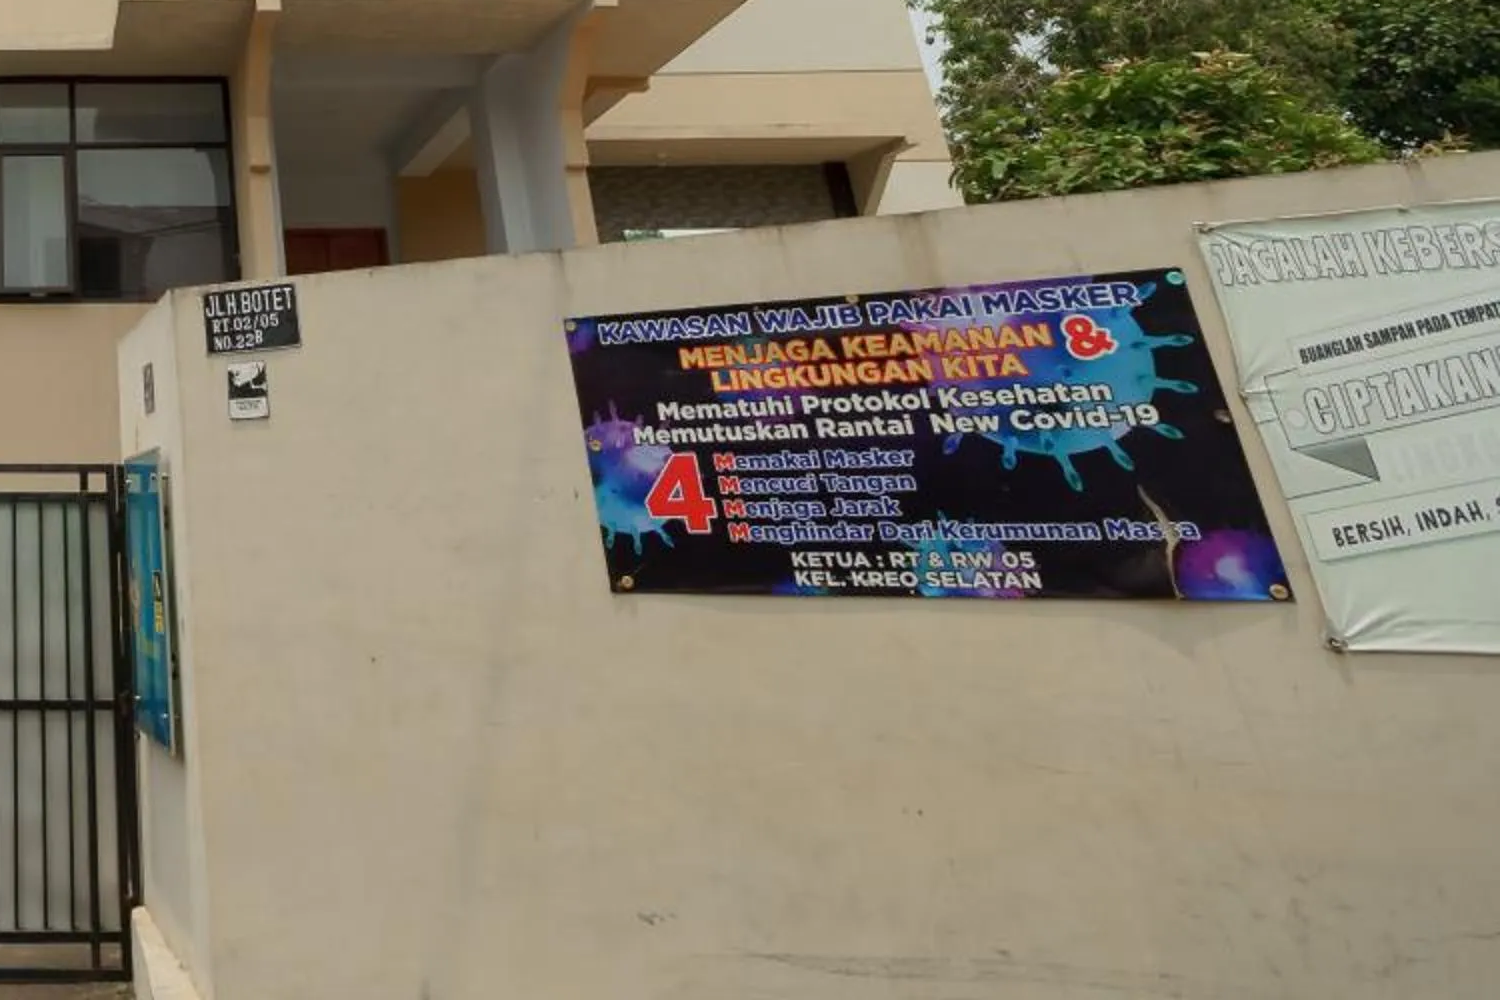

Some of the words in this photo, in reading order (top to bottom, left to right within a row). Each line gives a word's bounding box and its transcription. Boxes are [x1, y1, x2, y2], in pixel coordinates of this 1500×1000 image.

[1210, 233, 1368, 287] JAGALAH
[212, 312, 280, 334] RT.02/05
[599, 312, 751, 345] KAWASAN
[753, 304, 861, 333] WAJIB
[867, 294, 974, 325] PAKAI
[982, 281, 1143, 317] MASKER
[678, 338, 837, 370] MENJAGA
[841, 322, 1056, 359] KEAMANAN
[1060, 313, 1119, 361] &
[1299, 335, 1365, 364] BUANGLAH
[1362, 322, 1417, 349] SAMPAH
[1414, 313, 1452, 337] PADA
[711, 357, 935, 393] LINGKUNGAN
[941, 351, 1030, 380] KITA
[656, 396, 794, 422] Mematuhi
[800, 388, 932, 415] Protokol
[937, 382, 1113, 410] Kesehatan
[632, 418, 809, 447] Memutuskan
[815, 412, 916, 439] Rantai
[930, 411, 1000, 437] New
[1008, 403, 1161, 431] Covid-19
[712, 450, 821, 472] Memakai
[823, 447, 916, 470] Masker
[644, 452, 717, 535] 4
[717, 473, 819, 496] Mencuci
[820, 472, 917, 494] Tangan
[722, 499, 828, 522] Menjaga
[829, 496, 904, 518] Jarak
[728, 520, 875, 545] Menghindar
[878, 519, 934, 543] Dari
[939, 517, 1103, 543] Kerumunan
[790, 551, 870, 569] KETUA
[889, 551, 921, 569] RT
[927, 552, 945, 568] &
[950, 551, 994, 568] RW
[1001, 551, 1036, 569] 05
[852, 571, 918, 588] KREO
[926, 570, 1043, 589] SELATAN
